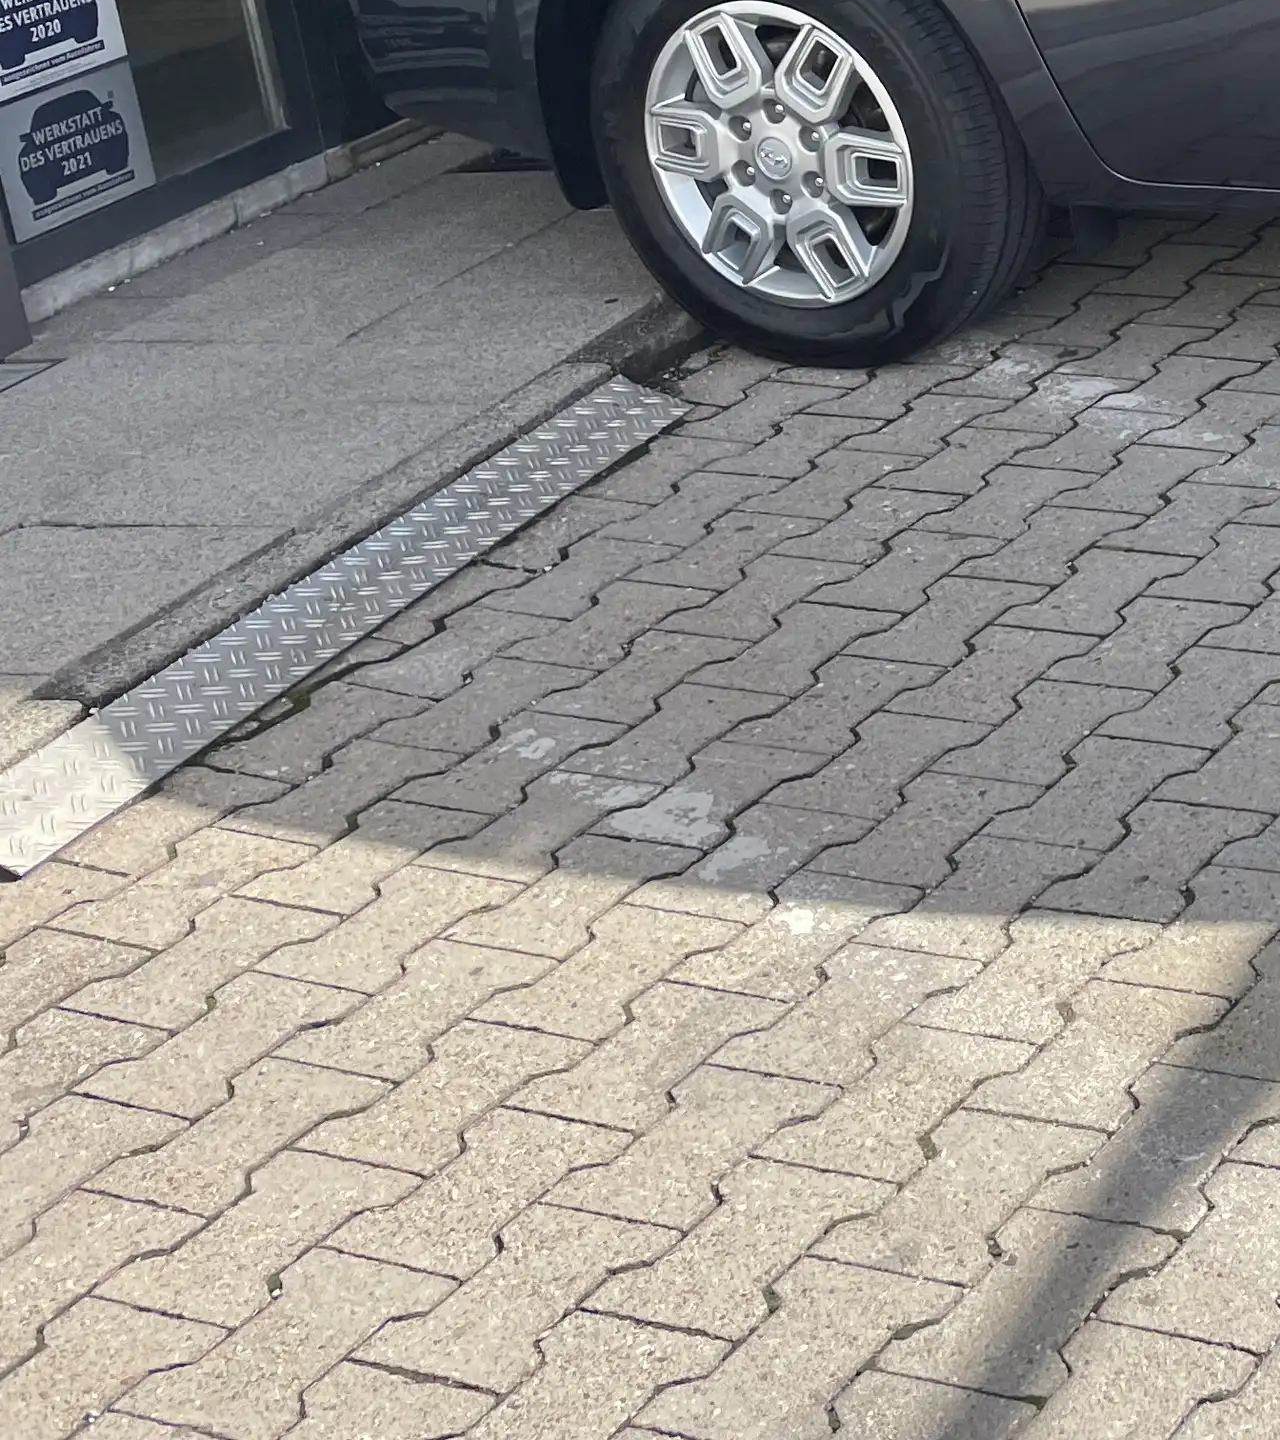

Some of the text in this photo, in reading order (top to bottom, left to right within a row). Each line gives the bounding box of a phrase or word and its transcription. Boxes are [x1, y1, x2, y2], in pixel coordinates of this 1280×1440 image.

[30, 18, 62, 42] 2020
[32, 107, 103, 146] WERKSTATT
[20, 119, 124, 172] DES VERTRAUENS
[61, 151, 93, 176] 2021
